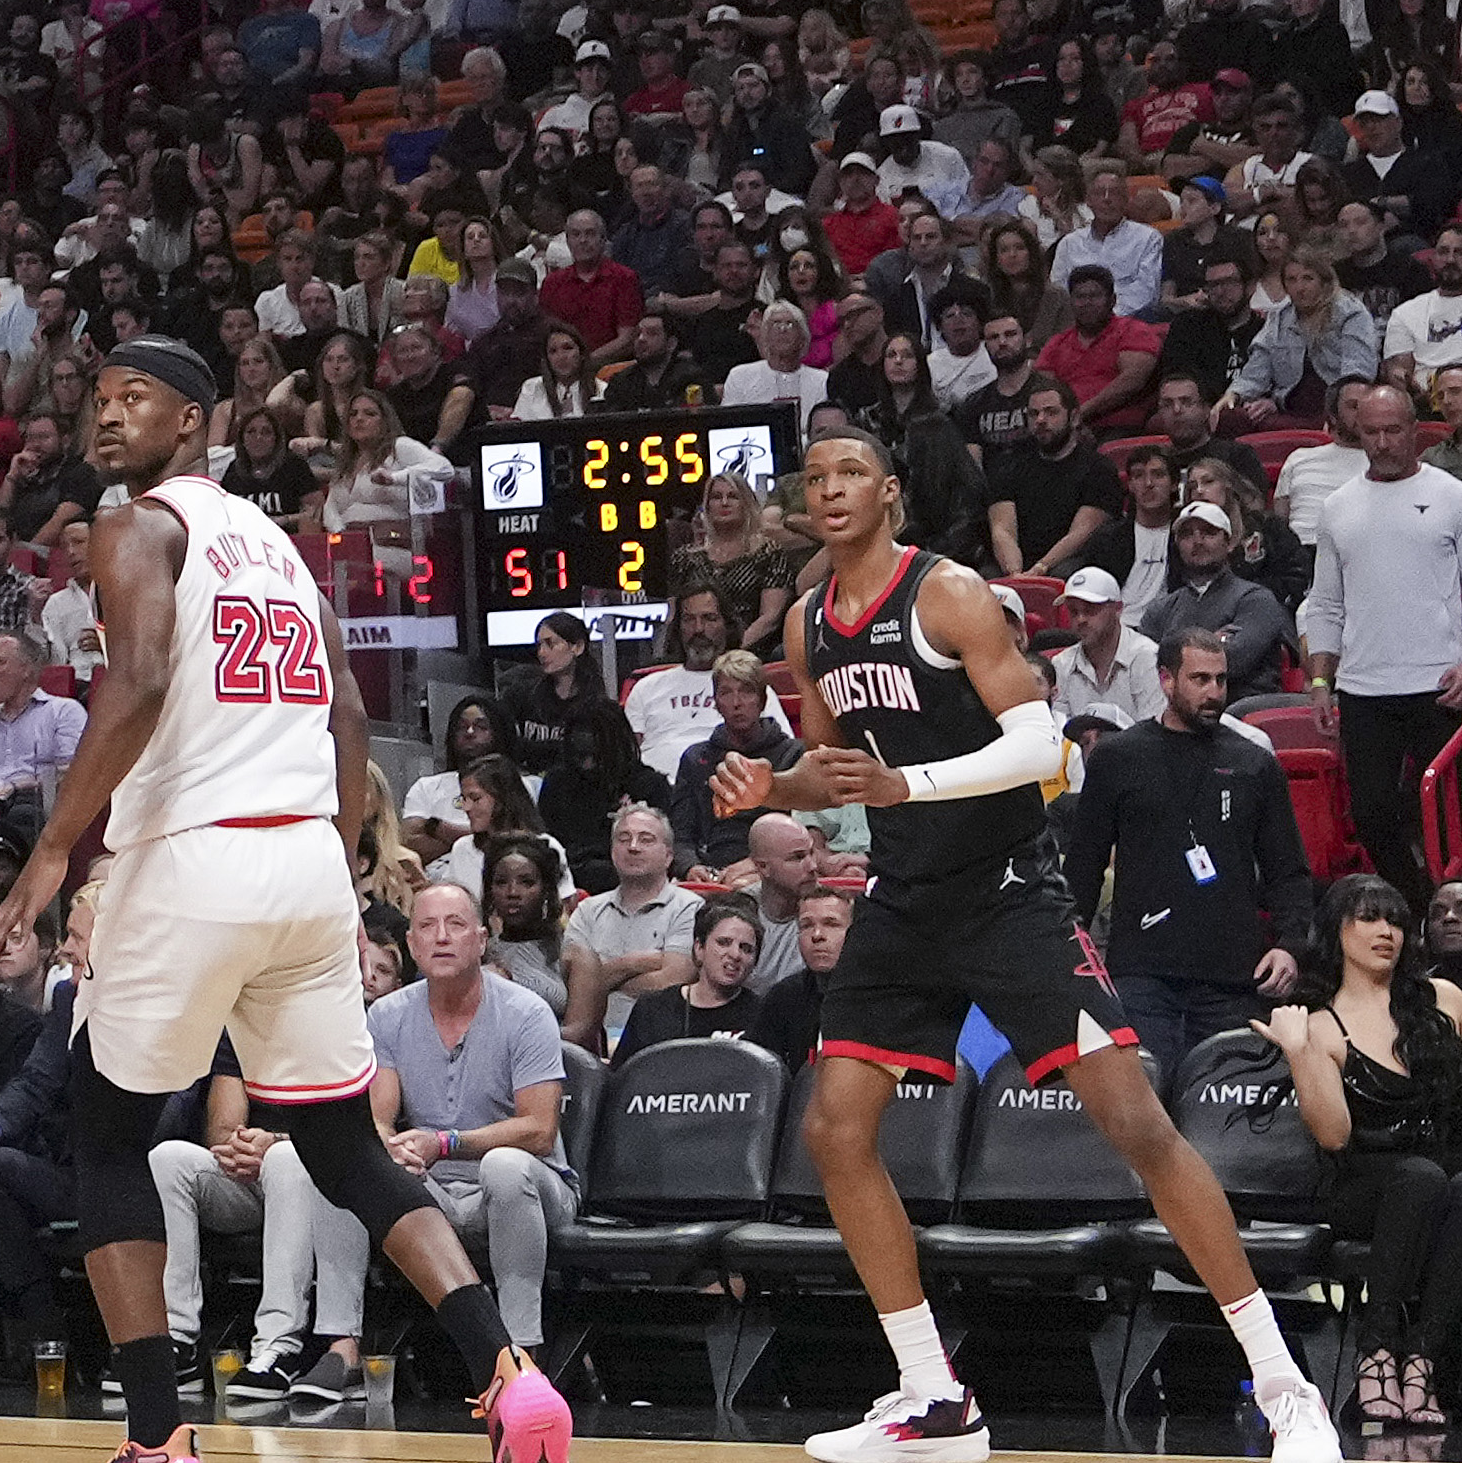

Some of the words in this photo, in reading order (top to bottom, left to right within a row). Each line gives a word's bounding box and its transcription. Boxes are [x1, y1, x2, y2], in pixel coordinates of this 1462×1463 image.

[584, 433, 703, 489] 2:55
[498, 514, 540, 534] HEAT
[206, 532, 296, 587] BUTLER
[505, 548, 568, 597] 51
[618, 541, 644, 593] 2
[213, 595, 329, 705] 22
[870, 632, 902, 645] karma
[872, 619, 900, 633] credit
[626, 1092, 751, 1114] AMERANT
